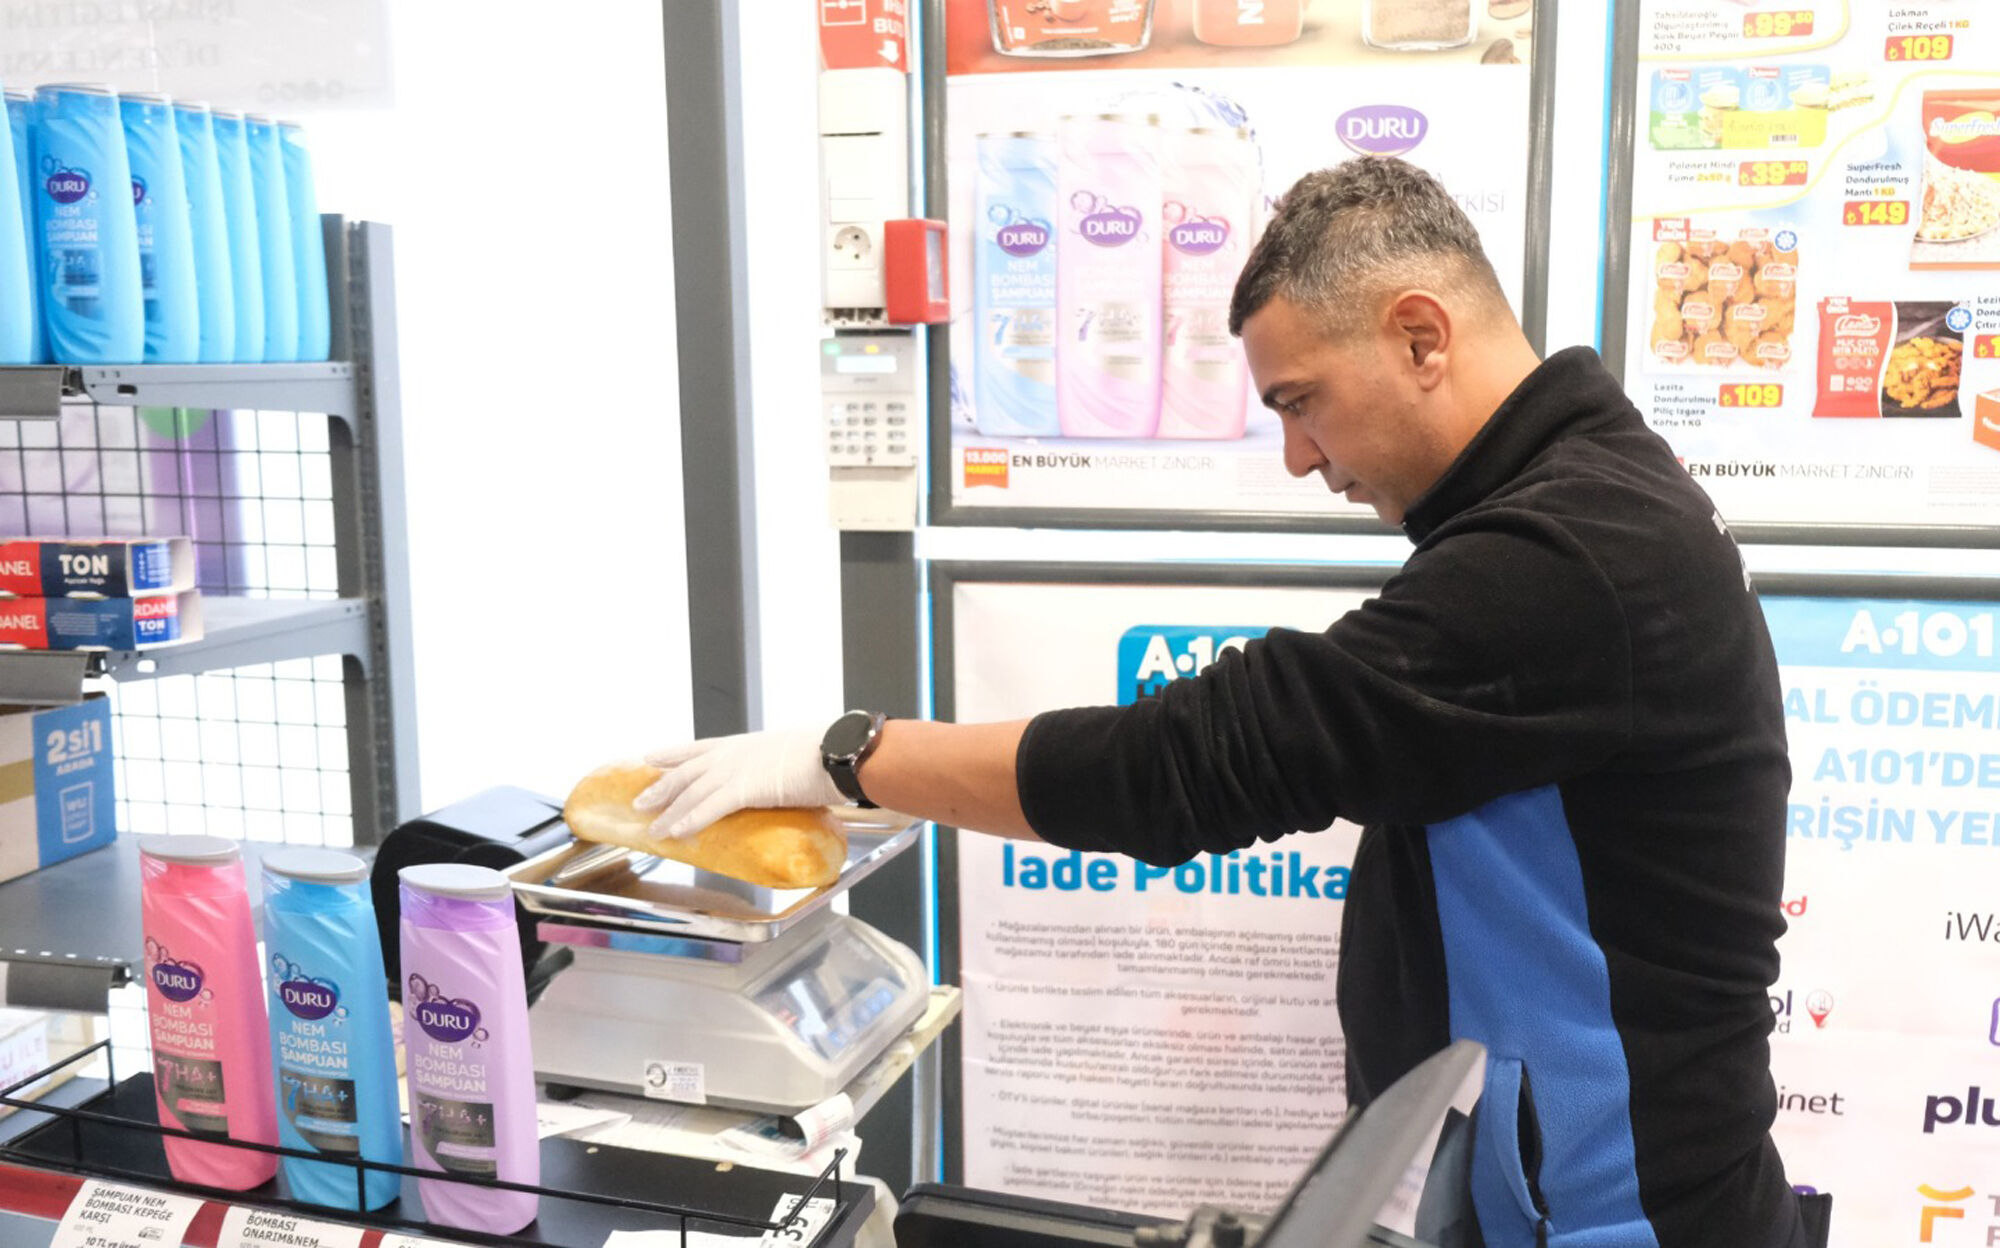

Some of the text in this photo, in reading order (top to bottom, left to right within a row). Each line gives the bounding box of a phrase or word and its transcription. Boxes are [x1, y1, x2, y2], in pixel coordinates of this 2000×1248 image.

[1888, 9, 1929, 18] Lokman
[1888, 22, 1914, 32] Çilek
[1915, 21, 1947, 31] Reçeli
[1346, 117, 1420, 140] DURU
[1845, 175, 1910, 186] Dondurulmuş
[1086, 220, 1135, 237] DURU
[1175, 229, 1223, 245] DURU
[1003, 231, 1045, 246] DURU
[1011, 455, 1033, 468] EN
[1036, 452, 1092, 469] BÜYÜK
[1094, 456, 1157, 470] MARKET
[1688, 464, 1712, 477] EN
[1715, 460, 1777, 478] BÜYÜK
[1779, 464, 1849, 479] MARKET
[58, 554, 109, 576] TON
[138, 619, 165, 631] TON
[1129, 925, 1142, 935] bir
[156, 970, 197, 991] DURU
[284, 987, 331, 1008] DURU
[163, 1002, 192, 1020] NEM
[421, 1009, 470, 1030] DURU
[153, 1012, 214, 1037] BOMBASI
[291, 1020, 326, 1038] NEM
[279, 1031, 348, 1055] BOMBASI
[428, 1043, 464, 1060] NEM
[280, 1046, 348, 1070] ŞAMPUAN
[414, 1053, 487, 1078] BOMBASI
[415, 1069, 487, 1093] ŞAMPUAN
[91, 1187, 168, 1209] ŞAMPUAN NEM
[78, 1210, 113, 1225] KARŞI
[84, 1198, 174, 1222] BOMBASI KEPEĞE
[245, 1214, 299, 1233] BOMBASI
[241, 1226, 320, 1248] ONARIM&NEM
